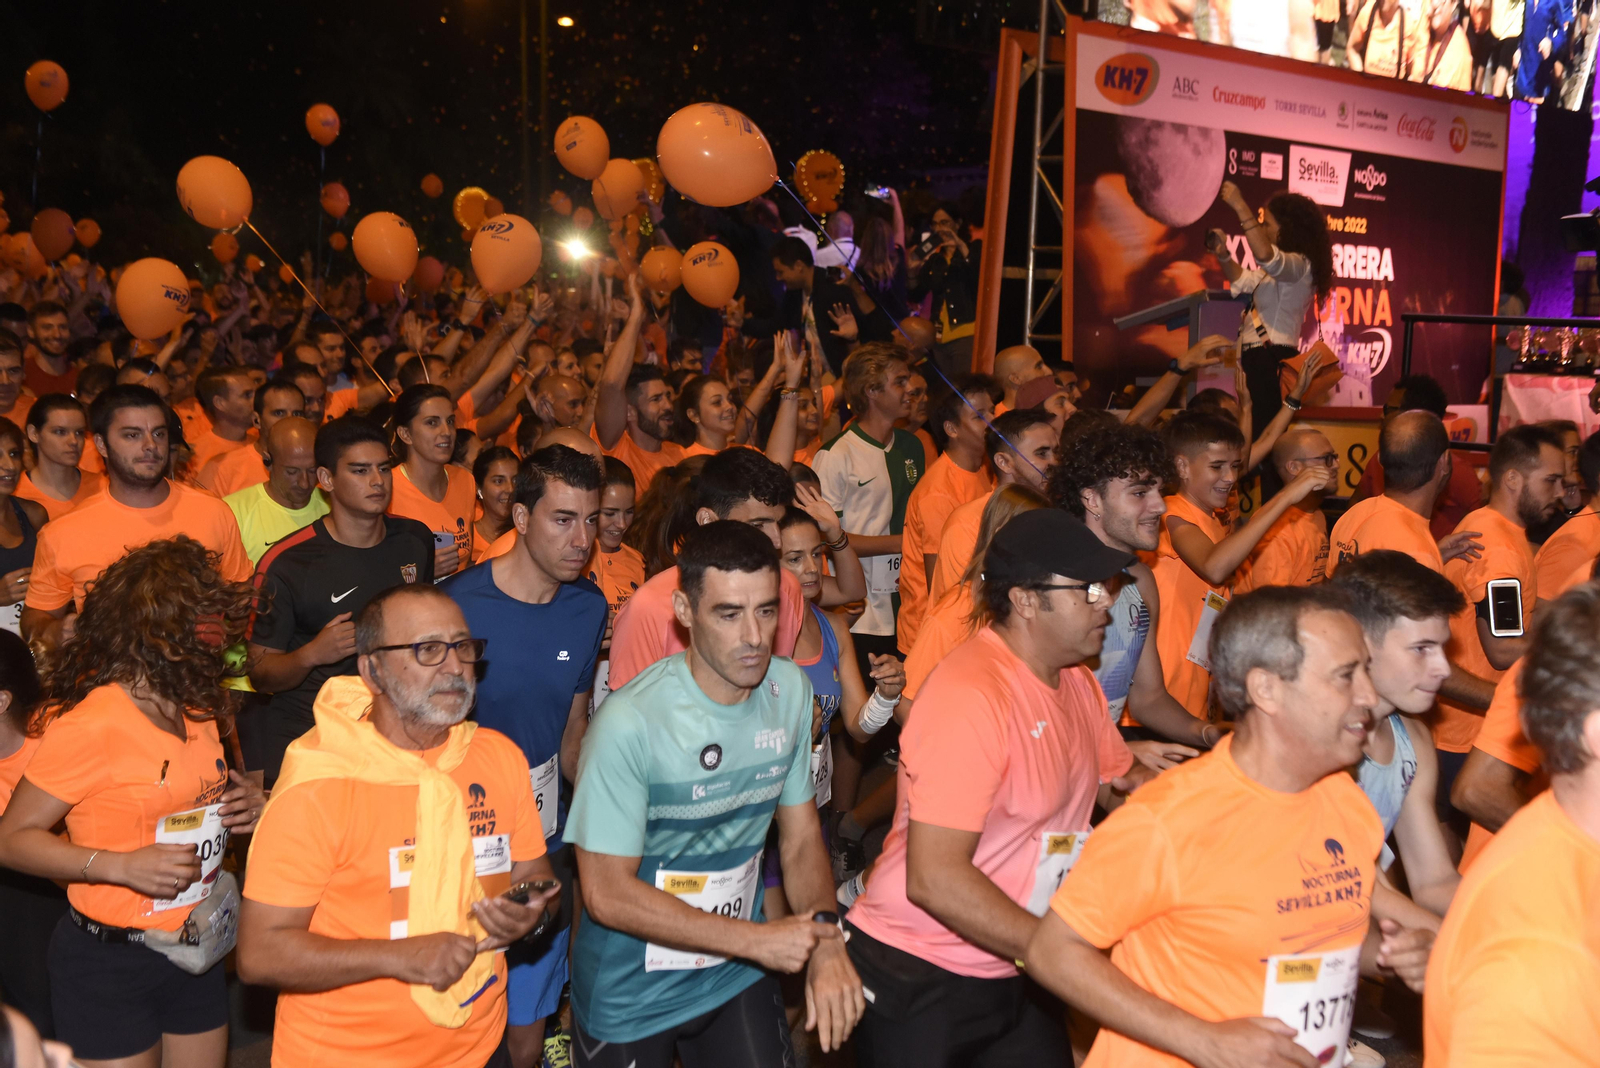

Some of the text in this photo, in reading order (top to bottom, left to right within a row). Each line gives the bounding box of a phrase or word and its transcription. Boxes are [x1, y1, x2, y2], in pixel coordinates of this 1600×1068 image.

[1173, 77, 1199, 95] ABC
[1212, 86, 1266, 110] Cruzcampo
[1242, 151, 1255, 163] IMD
[1344, 217, 1367, 234] 2022
[1332, 243, 1394, 281] RRERA
[1302, 866, 1361, 889] NOCTURNA
[1277, 891, 1332, 914] SEVILLA
